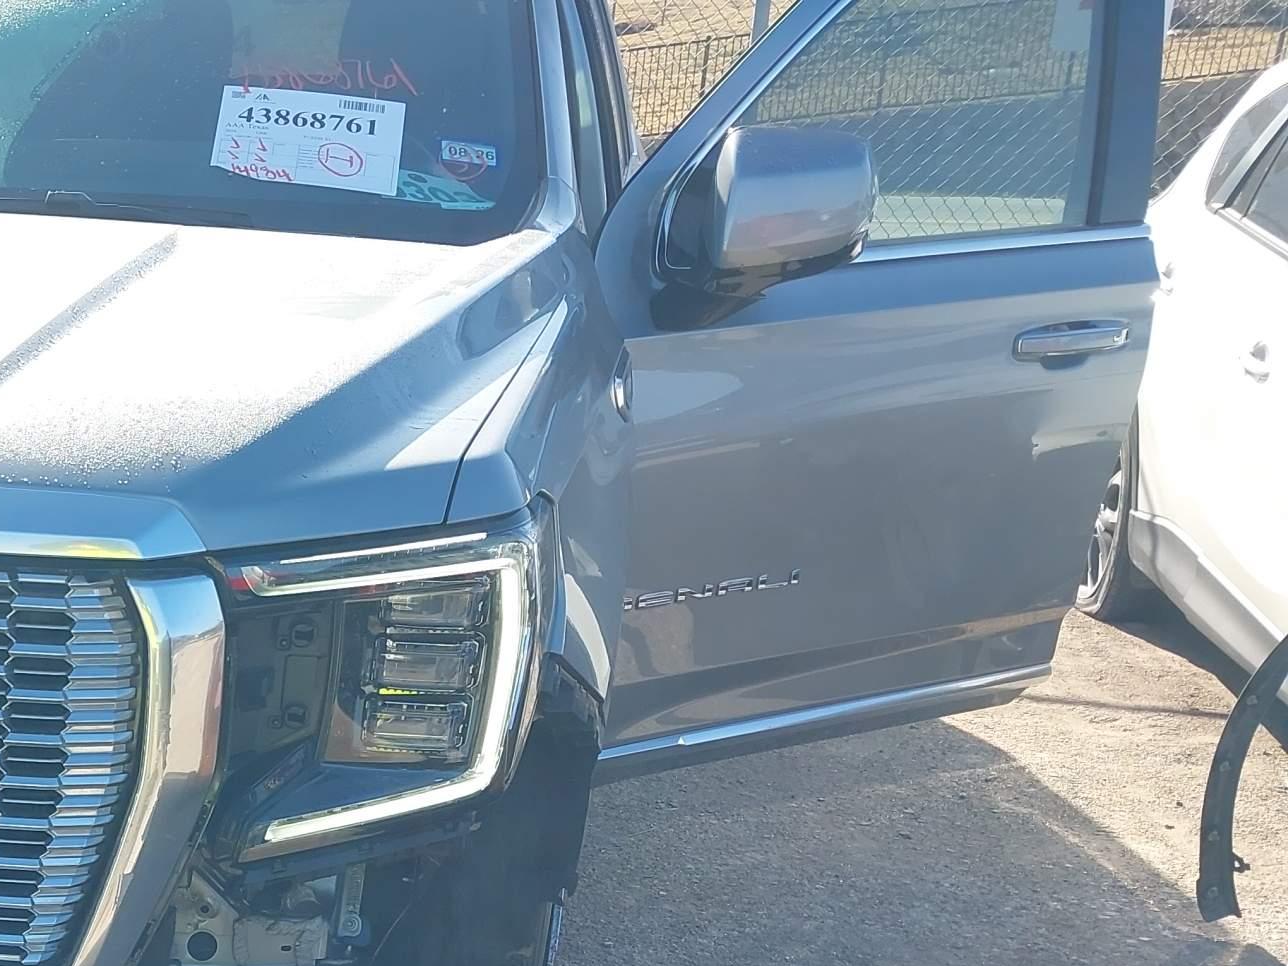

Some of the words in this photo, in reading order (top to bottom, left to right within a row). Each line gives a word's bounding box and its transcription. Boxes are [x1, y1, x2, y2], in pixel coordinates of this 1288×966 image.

[238, 106, 377, 136] 43868761
[448, 146, 467, 157] 08
[623, 568, 801, 610] ENALI
